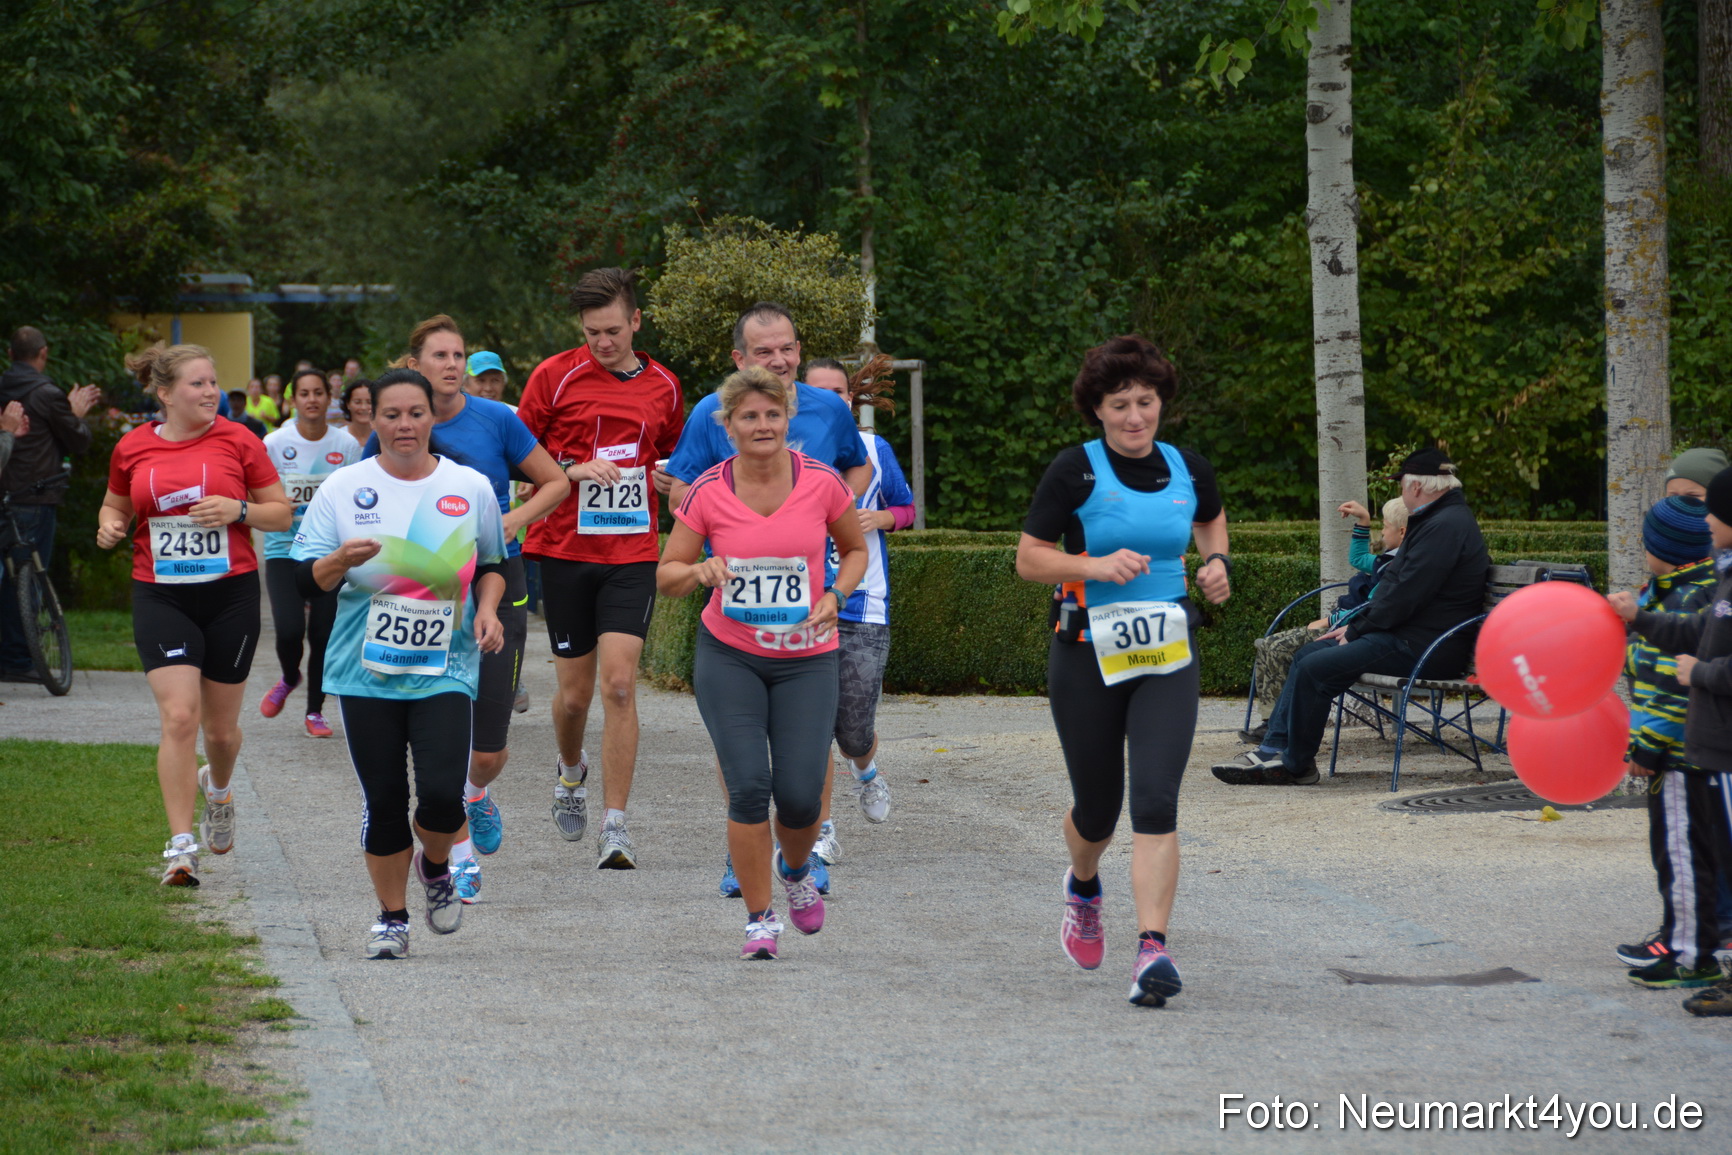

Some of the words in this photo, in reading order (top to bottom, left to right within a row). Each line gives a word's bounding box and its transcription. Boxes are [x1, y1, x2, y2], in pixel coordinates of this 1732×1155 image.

[607, 448, 626, 456] DEHN
[170, 493, 189, 503] DEHN
[587, 484, 642, 508] 2123
[440, 500, 466, 511] Hervis
[593, 514, 636, 525] Christoph
[159, 530, 220, 556] 2430
[174, 563, 206, 573] Nicole
[752, 564, 794, 572] Neumarkt
[730, 574, 802, 604] 2178
[372, 600, 398, 611] PARTL
[400, 604, 440, 615] Neumarkt
[744, 611, 788, 622] Daniela
[1092, 610, 1122, 622] PARTL
[375, 612, 444, 646] 2582
[1112, 612, 1166, 649] 307
[379, 649, 429, 664] Jeannine
[1127, 651, 1166, 666] Margit
